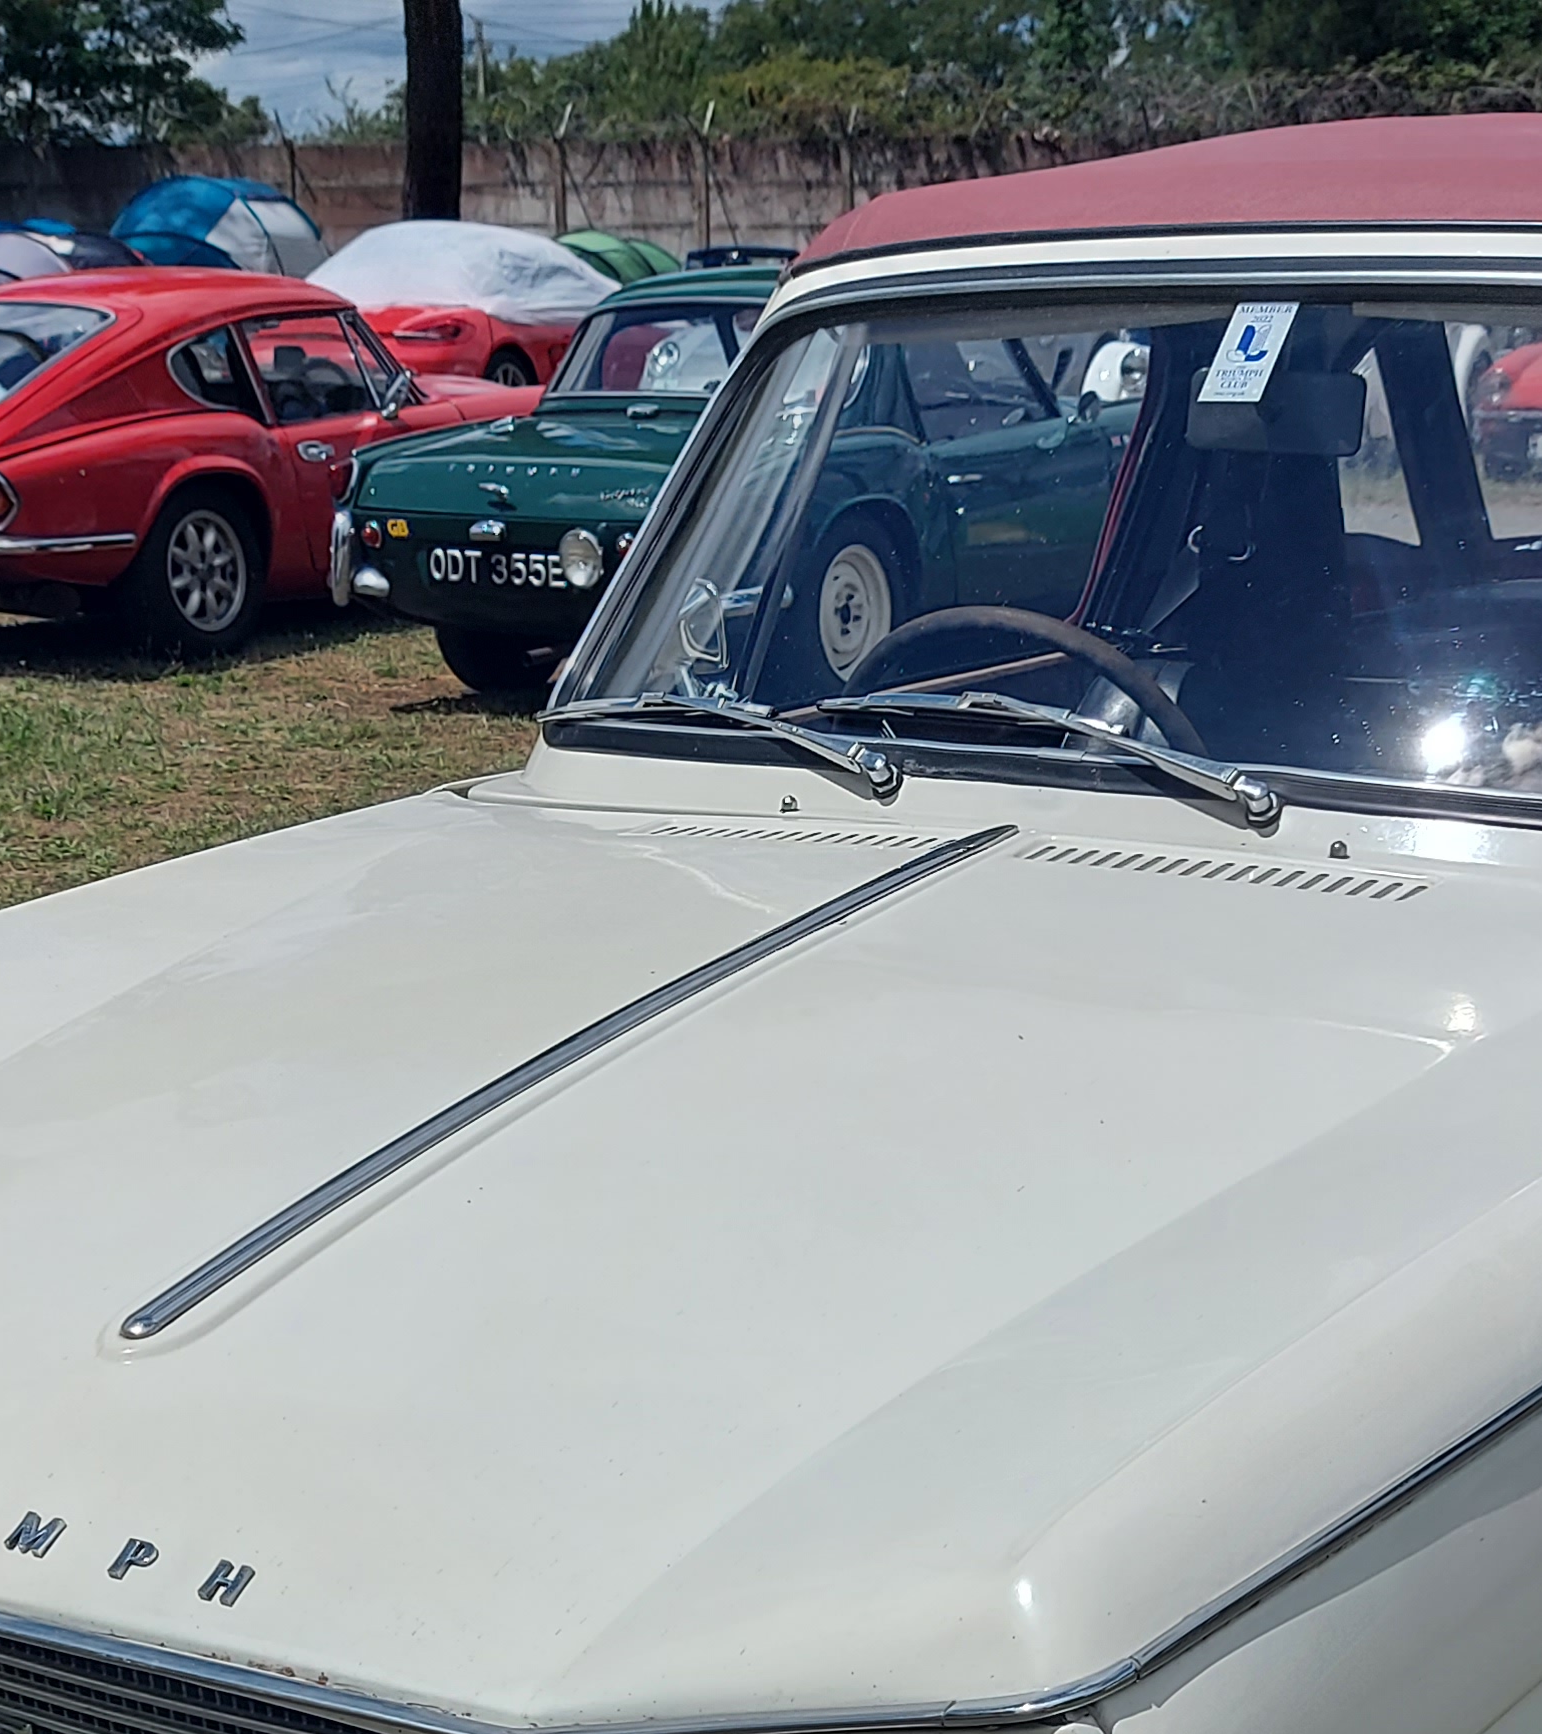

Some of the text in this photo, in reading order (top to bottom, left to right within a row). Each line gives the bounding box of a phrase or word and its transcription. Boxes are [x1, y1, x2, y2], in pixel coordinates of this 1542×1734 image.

[1239, 305, 1293, 314] MEMBER
[1215, 369, 1264, 378] TRIUMPH
[1219, 380, 1248, 389] CLUB
[429, 547, 567, 588] ODT 355E
